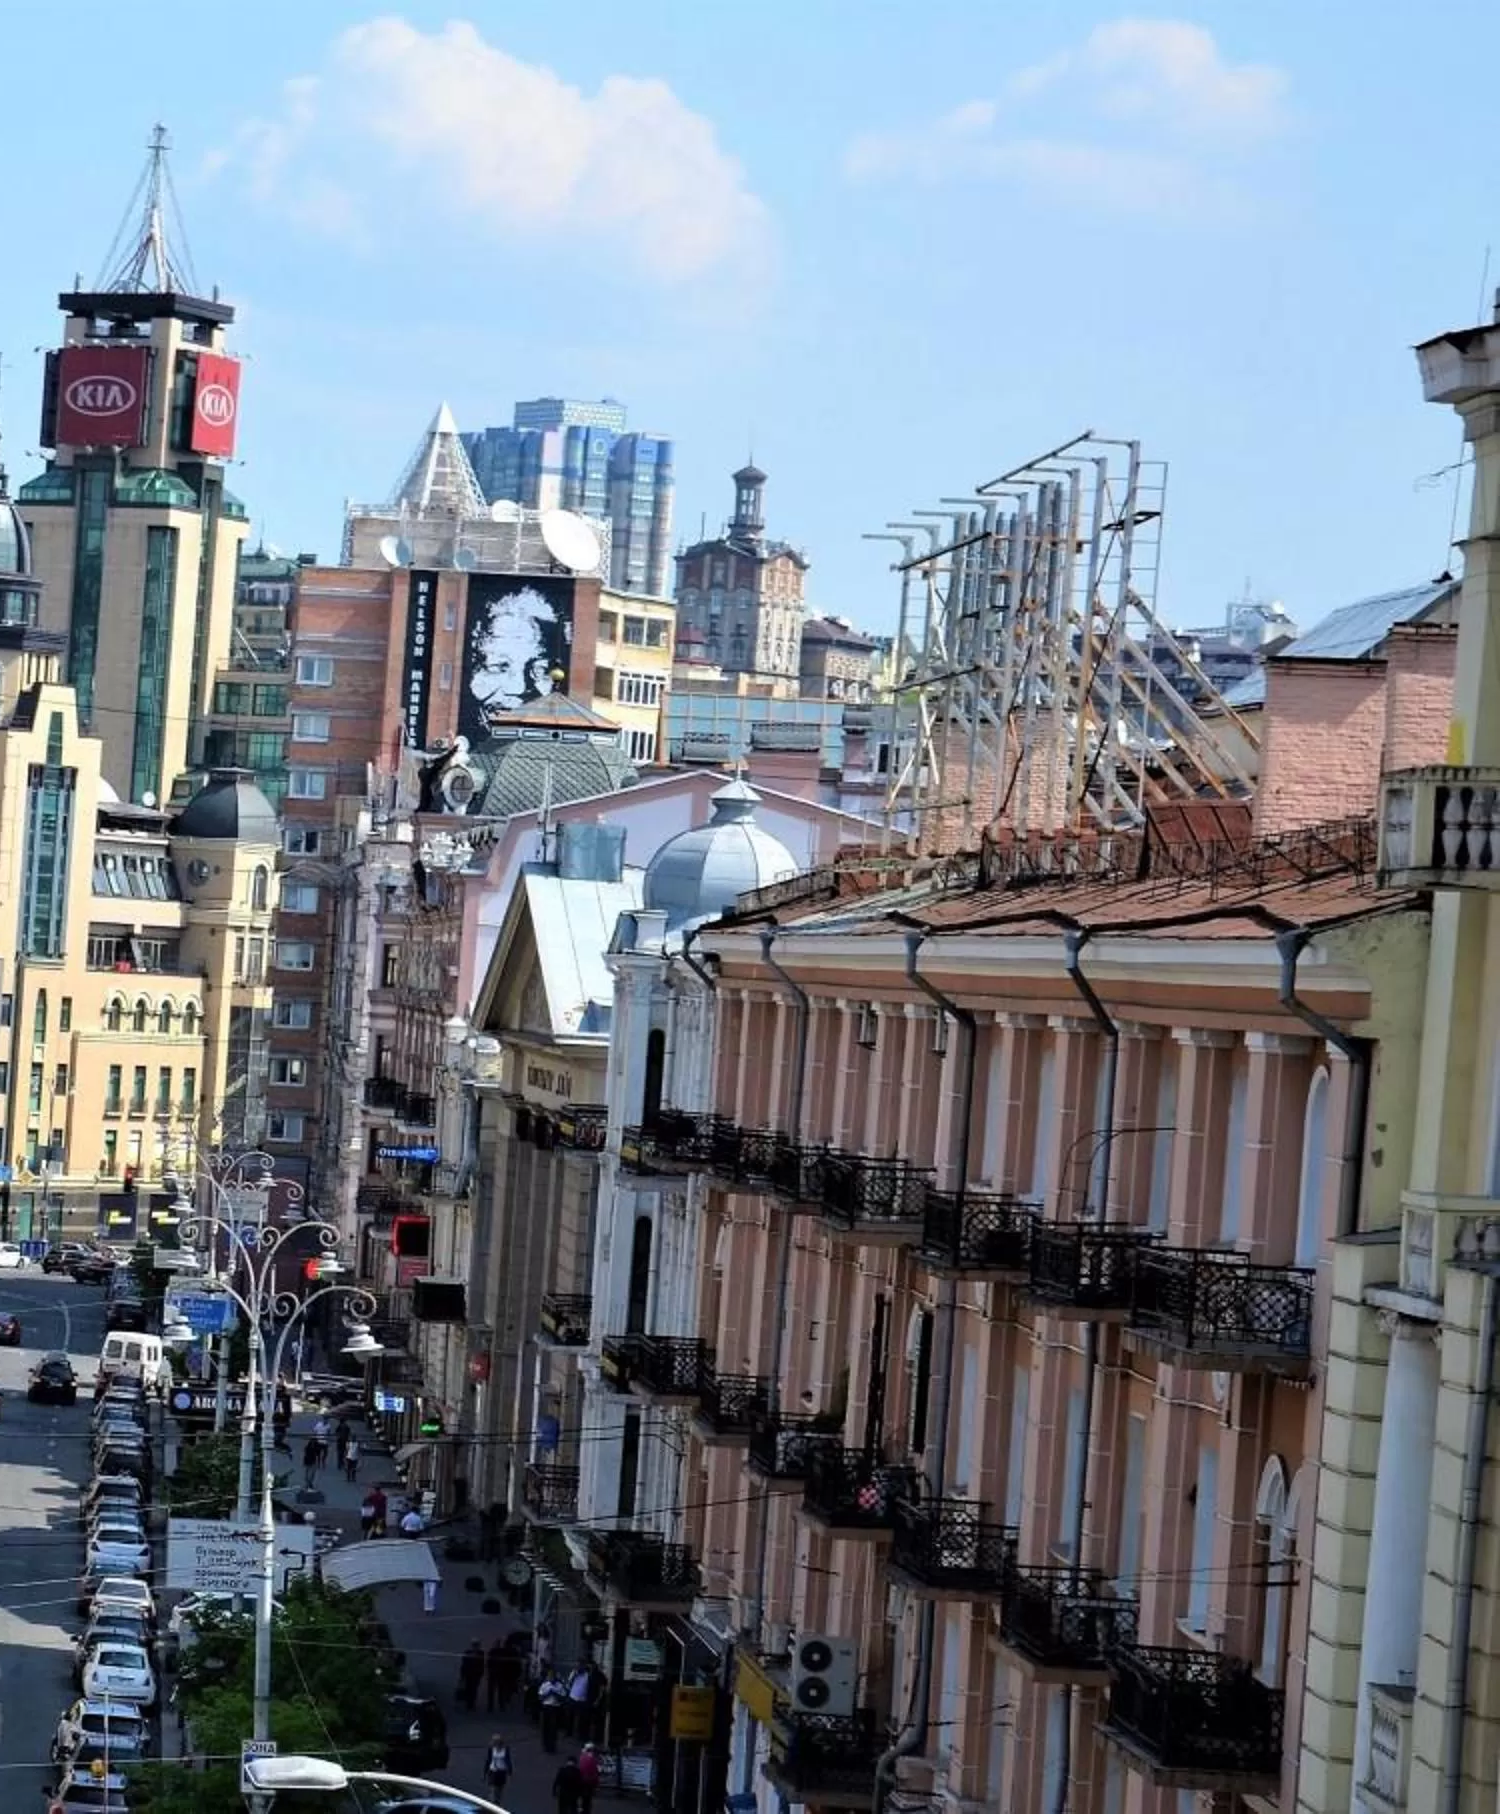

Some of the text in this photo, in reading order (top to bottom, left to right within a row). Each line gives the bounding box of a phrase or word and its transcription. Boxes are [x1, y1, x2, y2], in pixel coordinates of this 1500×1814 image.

[76, 384, 124, 408] KIA
[204, 392, 228, 417] KIA
[413, 580, 429, 657] NELSON
[243, 1741, 275, 1752] ЗОНА
